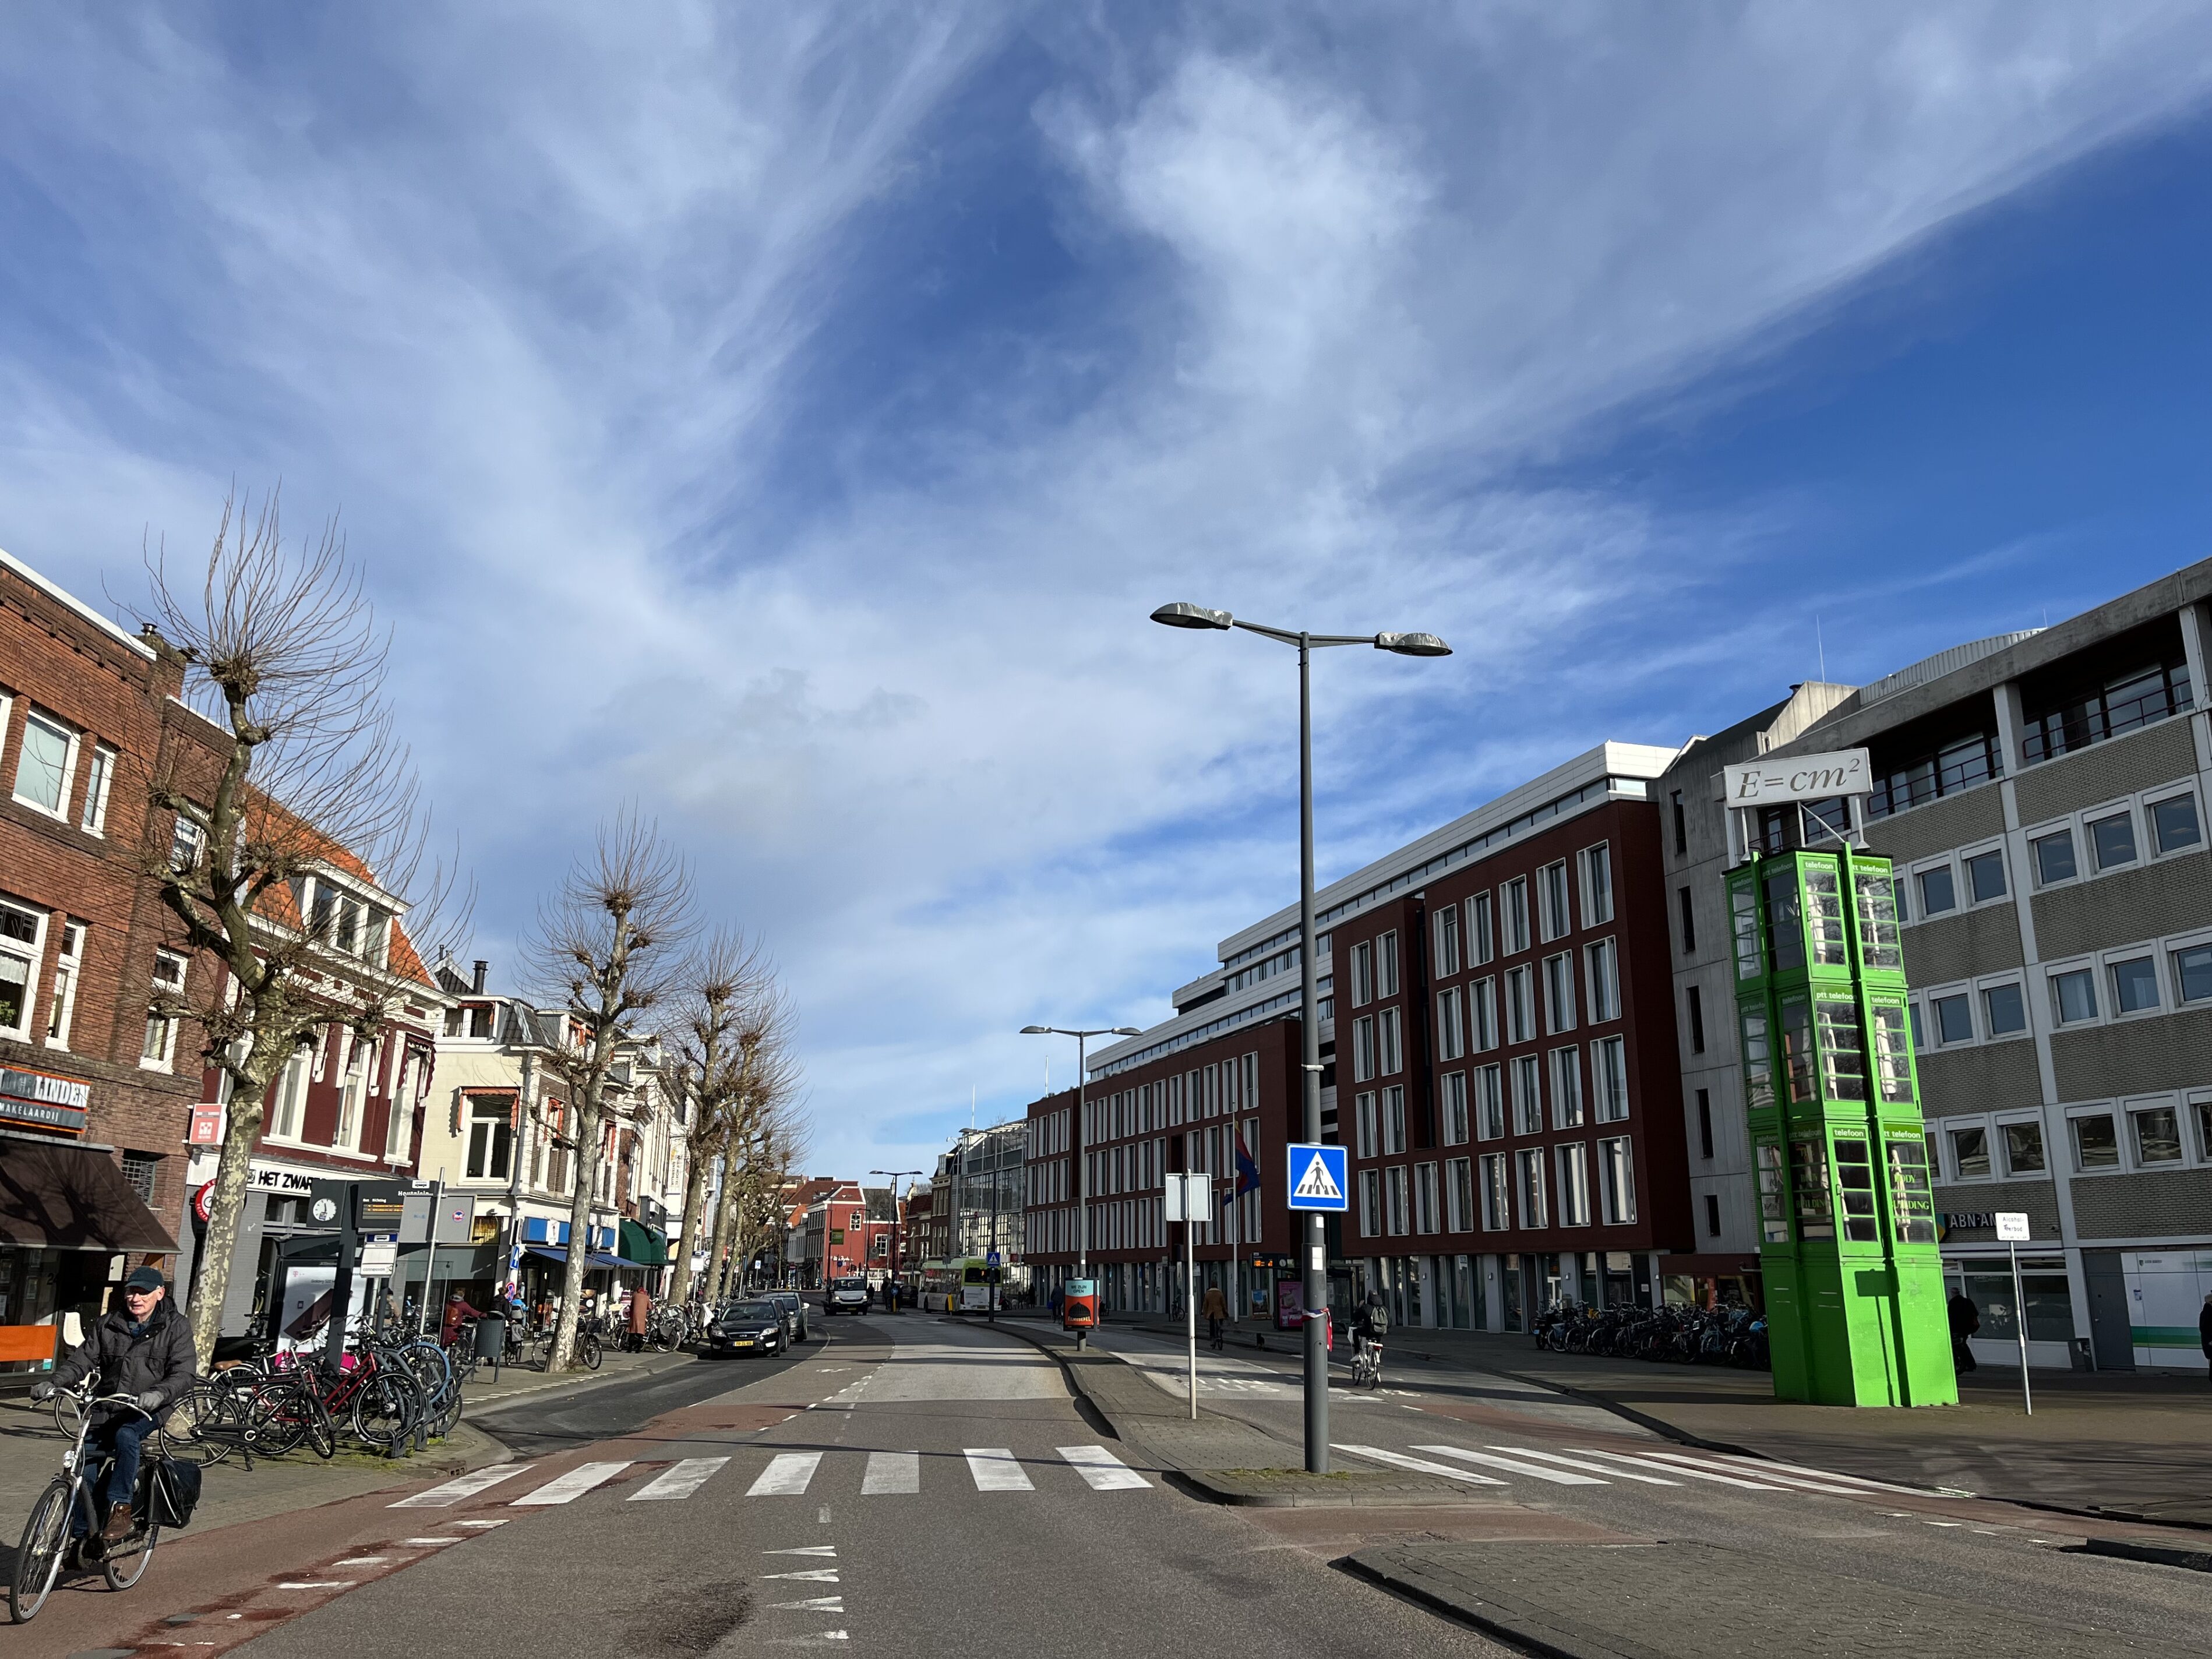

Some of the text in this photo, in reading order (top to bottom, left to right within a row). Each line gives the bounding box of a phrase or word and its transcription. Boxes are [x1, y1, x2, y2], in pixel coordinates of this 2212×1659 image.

[1772, 863, 1794, 874] telefoon
[1805, 862, 1833, 870] telefoon
[1860, 865, 1888, 873] telefoon
[1783, 995, 1805, 1004] telefoon
[1749, 1003, 1766, 1011] telefo
[34, 1075, 90, 1107] LINDEN
[0, 1102, 58, 1122] MAKELAARDIJ
[1834, 1129, 1864, 1137] telefoon
[1892, 1131, 1921, 1139] telefoon
[258, 1170, 317, 1191] HET ZWAR
[1893, 1200, 1929, 1210] UILDING
